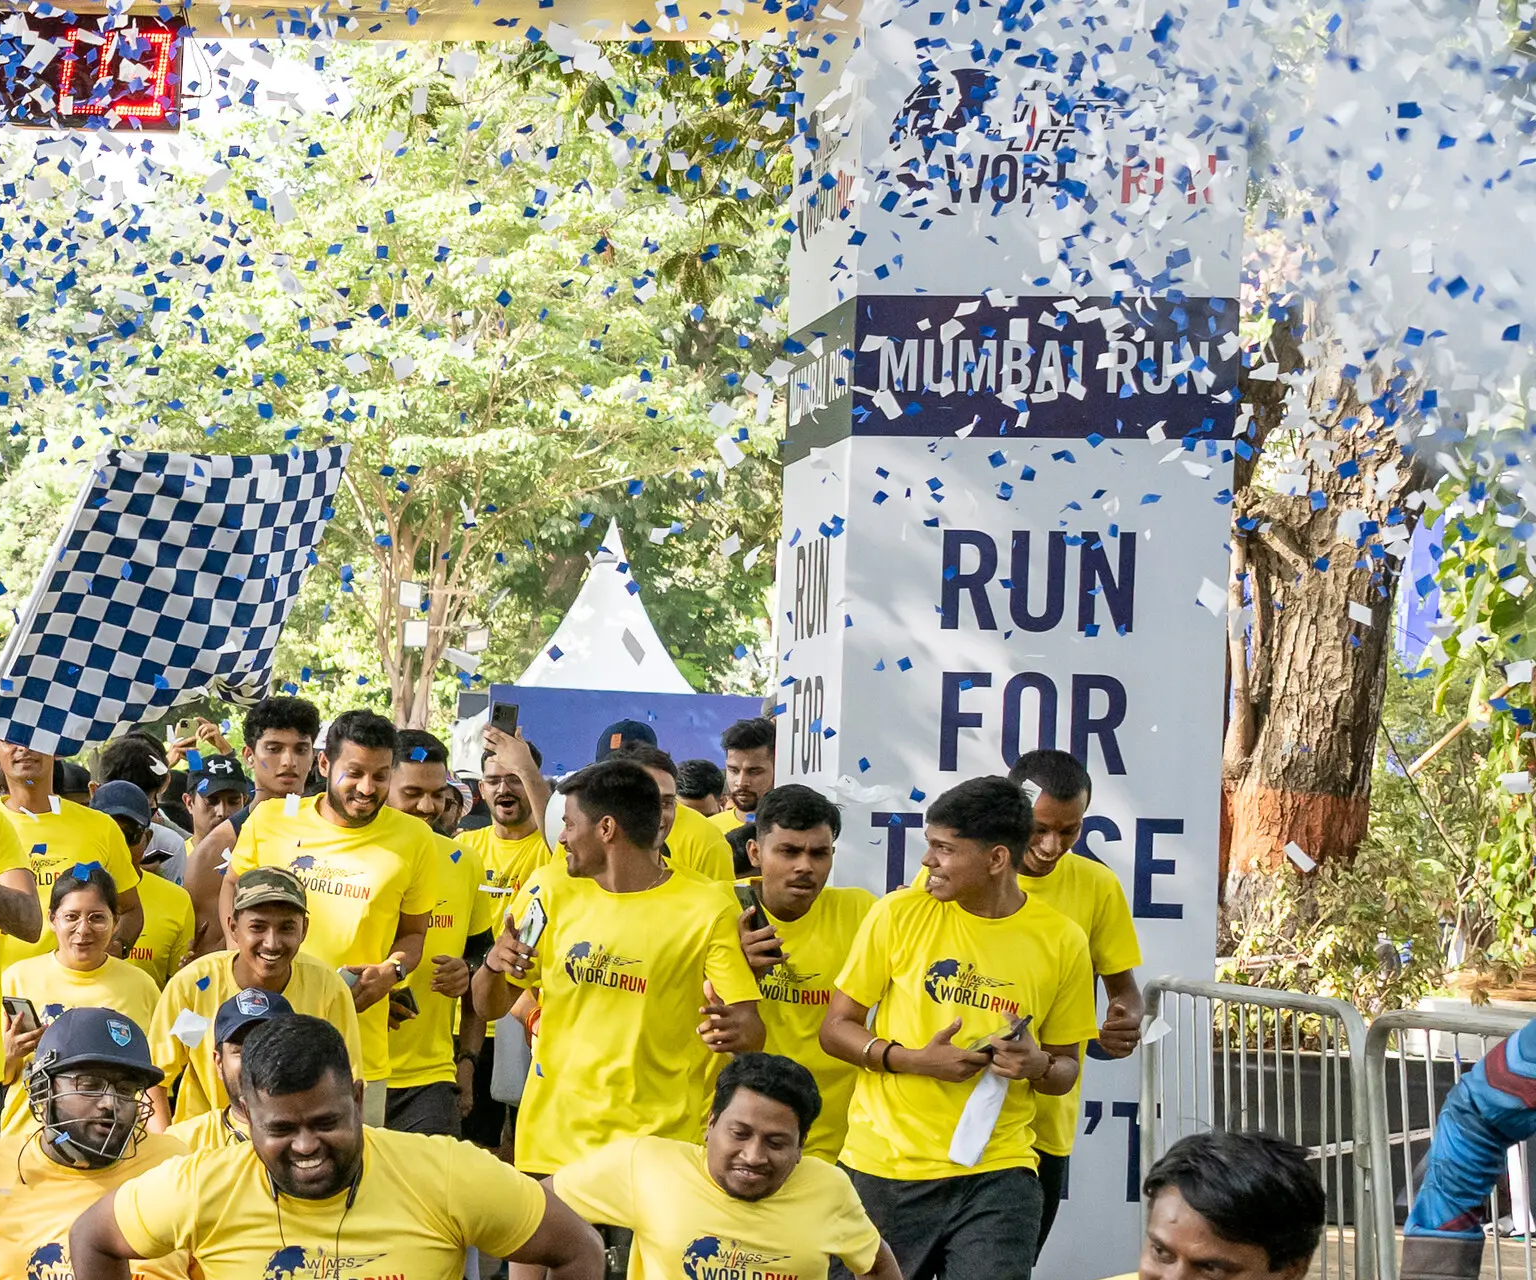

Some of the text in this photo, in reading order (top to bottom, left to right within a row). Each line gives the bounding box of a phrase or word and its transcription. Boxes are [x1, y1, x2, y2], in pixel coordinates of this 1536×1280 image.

[877, 338, 1212, 396] MUMBAI RUN
[793, 537, 831, 642] RUN
[939, 528, 1138, 634] RUN
[790, 674, 824, 776] FOR
[938, 670, 1128, 776] FOR
[299, 876, 371, 901] WORLD RUN
[434, 914, 453, 928] RUN
[130, 947, 153, 961] RUN
[576, 965, 647, 995] WORLD RUN
[801, 989, 831, 1006] RUN
[940, 984, 1021, 1015] WORLD RUN
[306, 1255, 355, 1270] WINGS
[719, 1248, 763, 1263] WINGS
[724, 1260, 749, 1270] LIFE
[313, 1268, 340, 1280] LIFE
